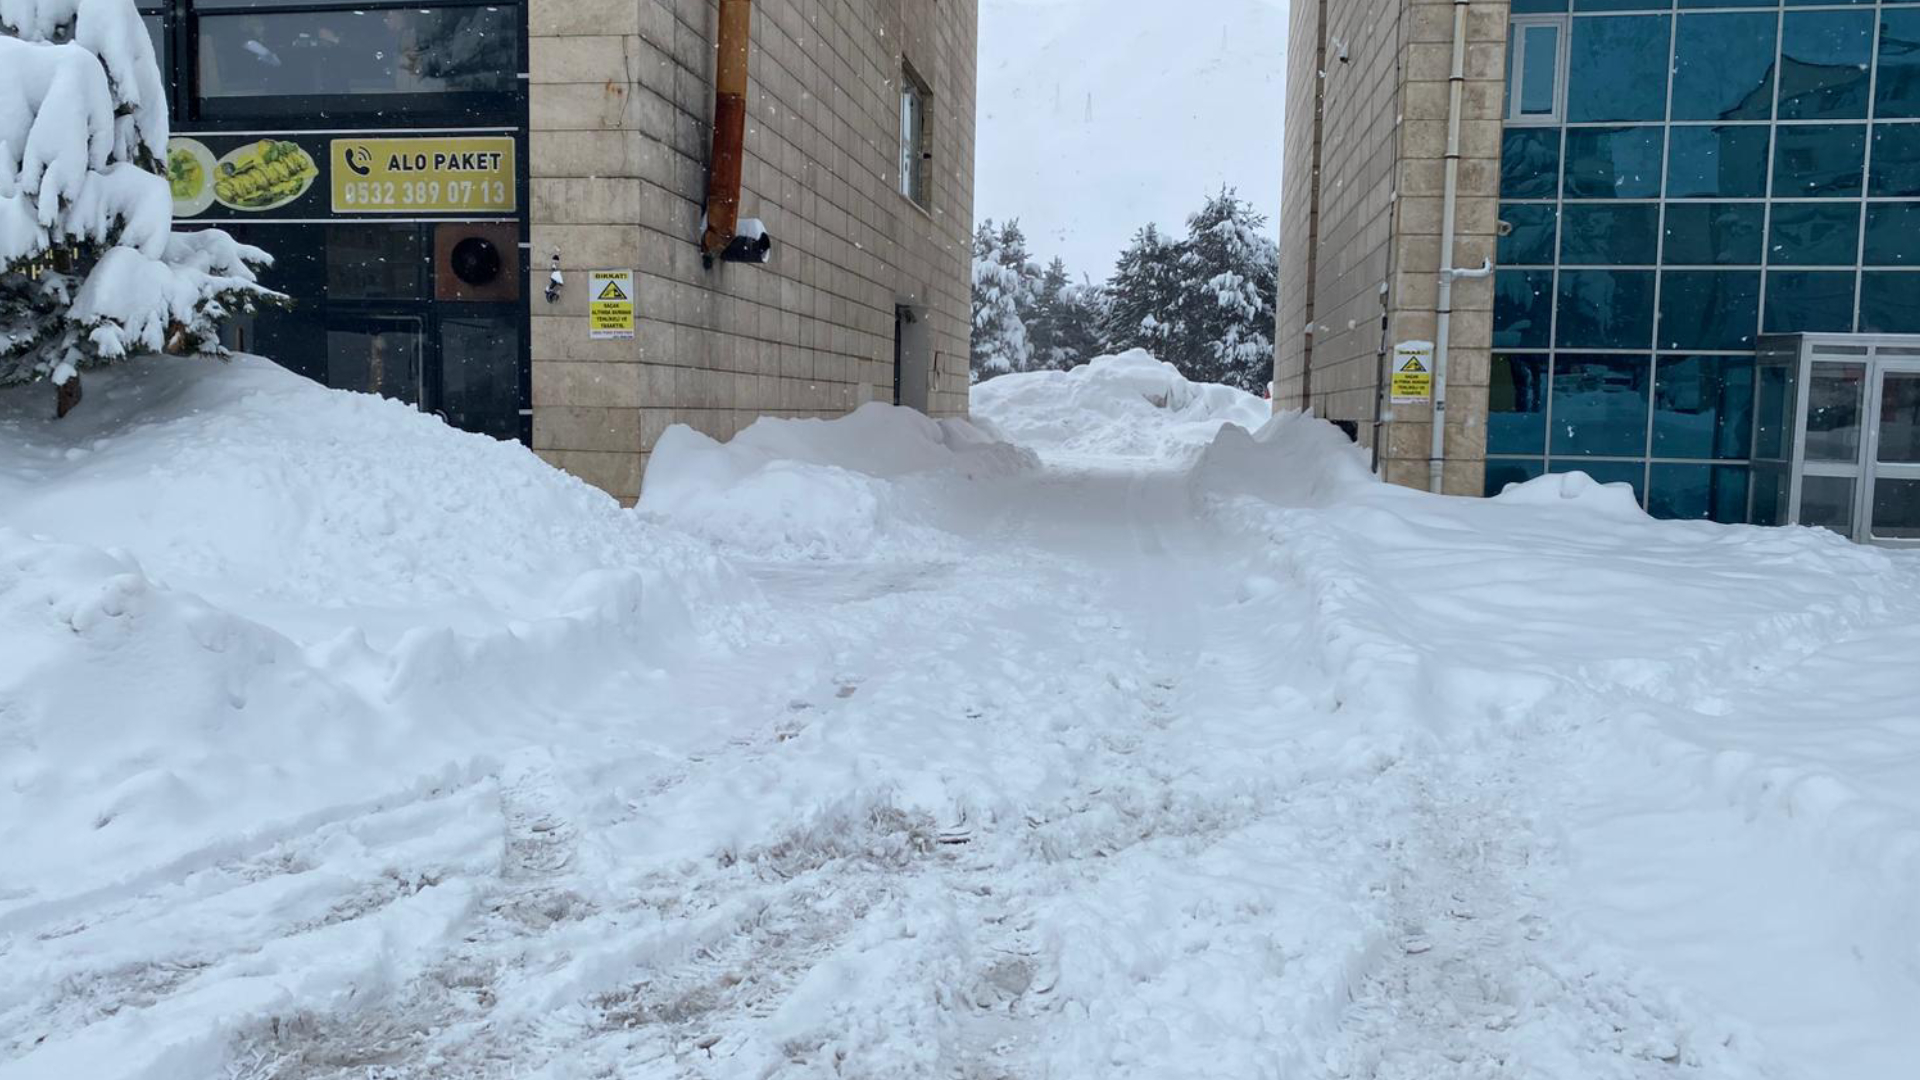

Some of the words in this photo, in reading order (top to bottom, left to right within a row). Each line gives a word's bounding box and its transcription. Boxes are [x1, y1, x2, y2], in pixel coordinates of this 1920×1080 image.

[387, 154, 427, 171] ALO
[433, 153, 502, 170] PAKET
[345, 181, 396, 204] 0532
[402, 181, 440, 204] 389
[447, 181, 473, 204] 07
[480, 180, 506, 203] 13
